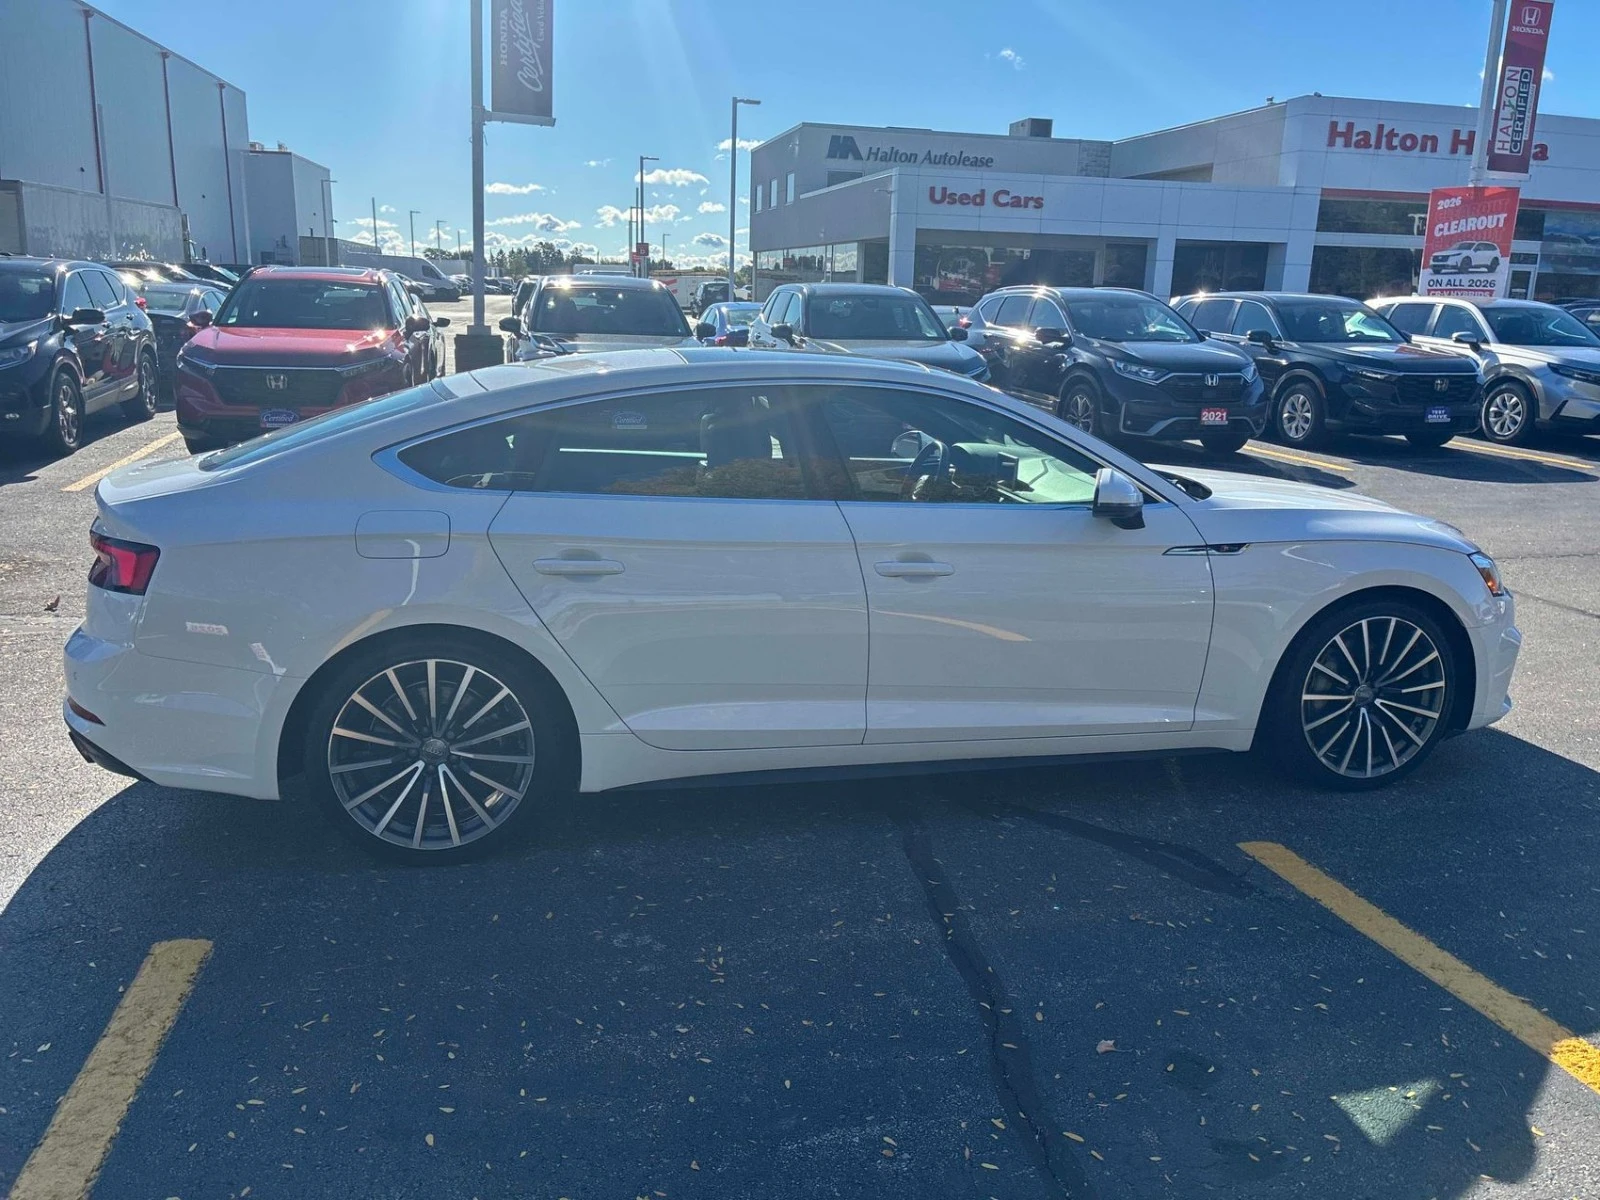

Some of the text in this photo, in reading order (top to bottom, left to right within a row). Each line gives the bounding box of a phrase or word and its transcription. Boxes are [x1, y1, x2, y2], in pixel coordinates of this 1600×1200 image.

[500, 8, 508, 66] HONDA
[1512, 25, 1545, 35] HONDA
[1497, 69, 1520, 151] HALTON
[1511, 70, 1531, 153] CERTIFIED
[1327, 120, 1439, 153] Halton
[866, 146, 994, 168] Halton Autolease
[929, 186, 1044, 209] Used Cars
[1437, 197, 1462, 210] 2026
[1434, 213, 1507, 237] CLEAROUT
[1428, 279, 1496, 288] ON ALL 2026
[1202, 411, 1228, 421] 2021
